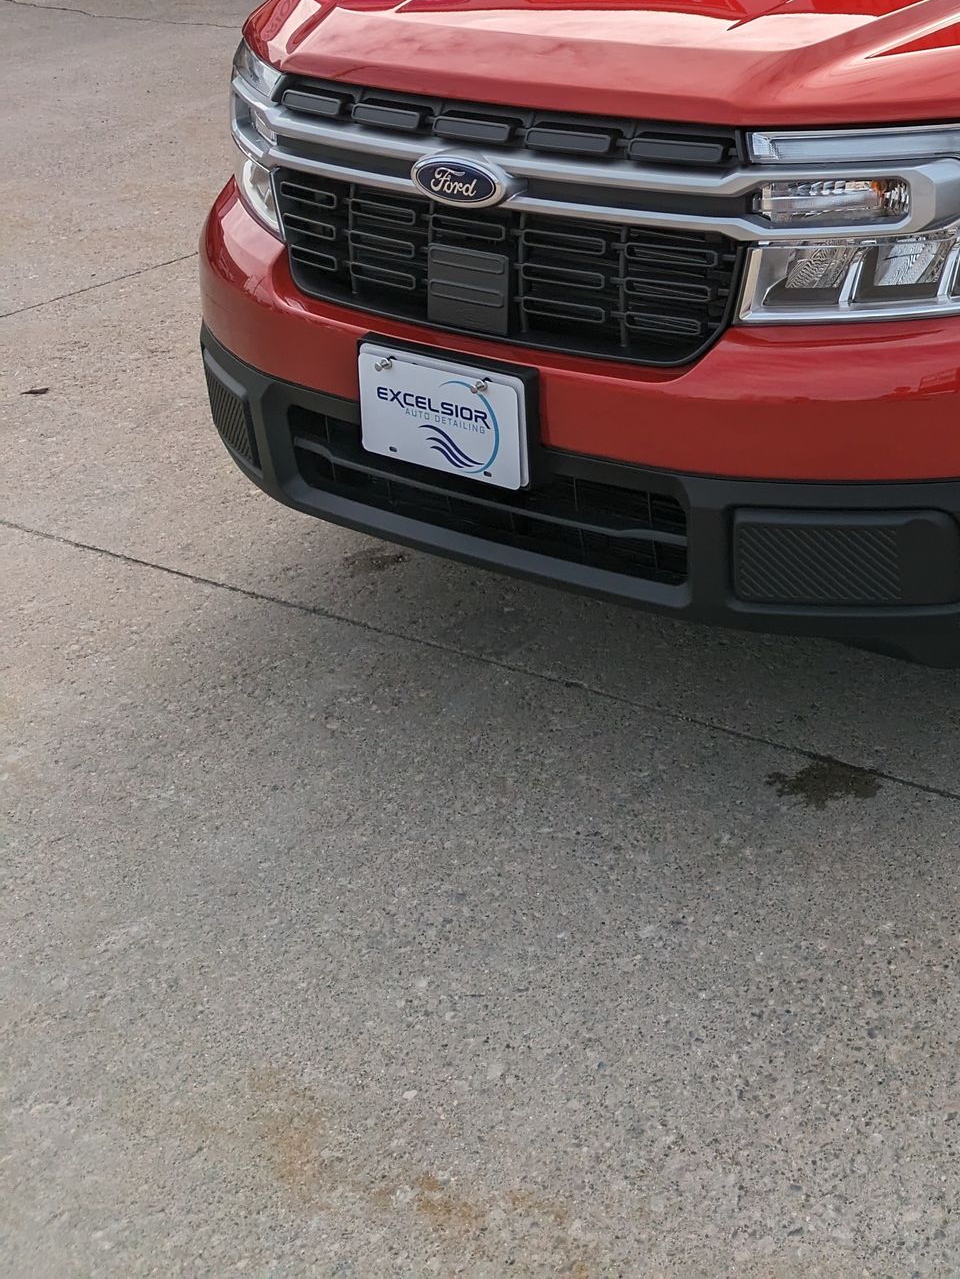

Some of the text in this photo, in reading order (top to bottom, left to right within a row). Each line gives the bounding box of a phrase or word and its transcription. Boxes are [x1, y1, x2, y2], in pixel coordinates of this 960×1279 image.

[430, 166, 478, 197] Ford
[376, 386, 491, 430] EXCELSIOR
[405, 408, 486, 435] AUTO DETAILING
